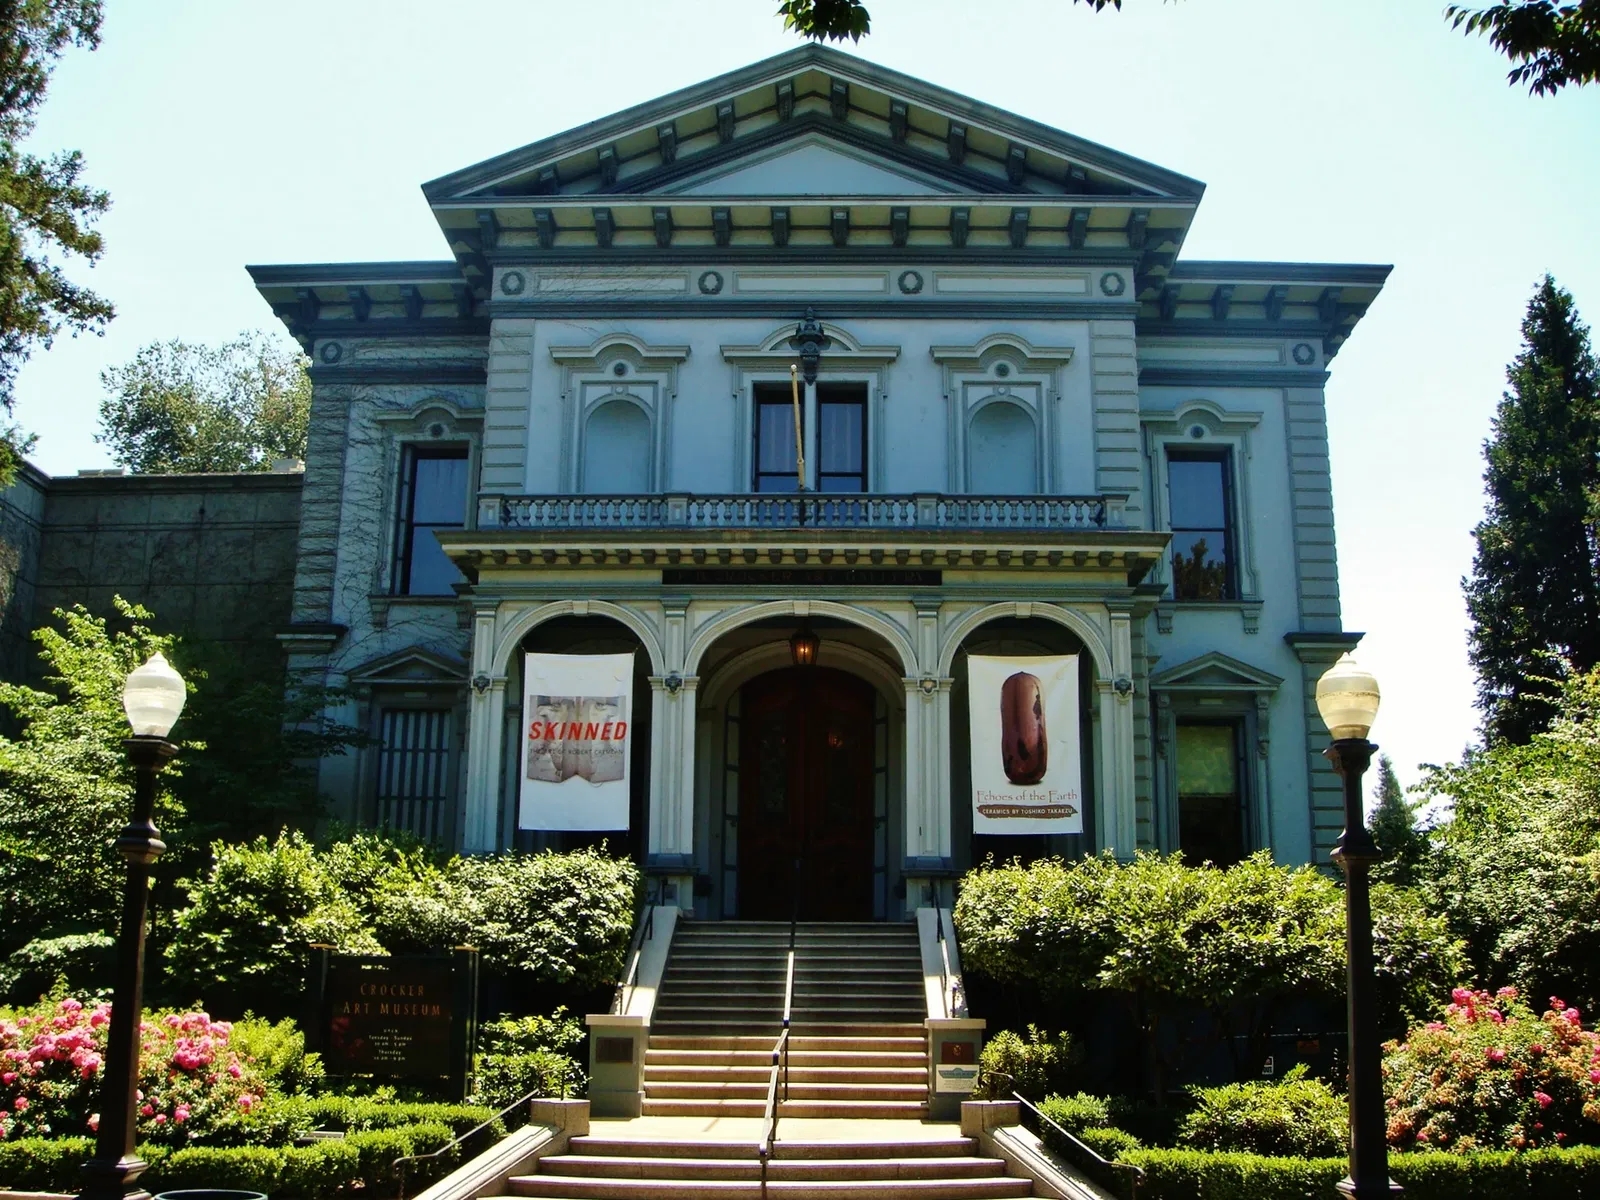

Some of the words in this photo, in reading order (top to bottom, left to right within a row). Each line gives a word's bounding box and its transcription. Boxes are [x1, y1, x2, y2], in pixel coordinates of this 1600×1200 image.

[528, 721, 627, 741] SKINNED
[568, 748, 592, 756] ROBERT
[976, 789, 1013, 803] Echoes
[1015, 789, 1028, 801] of
[1030, 789, 1046, 801] the
[1048, 789, 1078, 803] Earth
[360, 982, 424, 996] CROCKER
[343, 1001, 370, 1014] ART
[380, 1002, 440, 1016] MUSEUM
